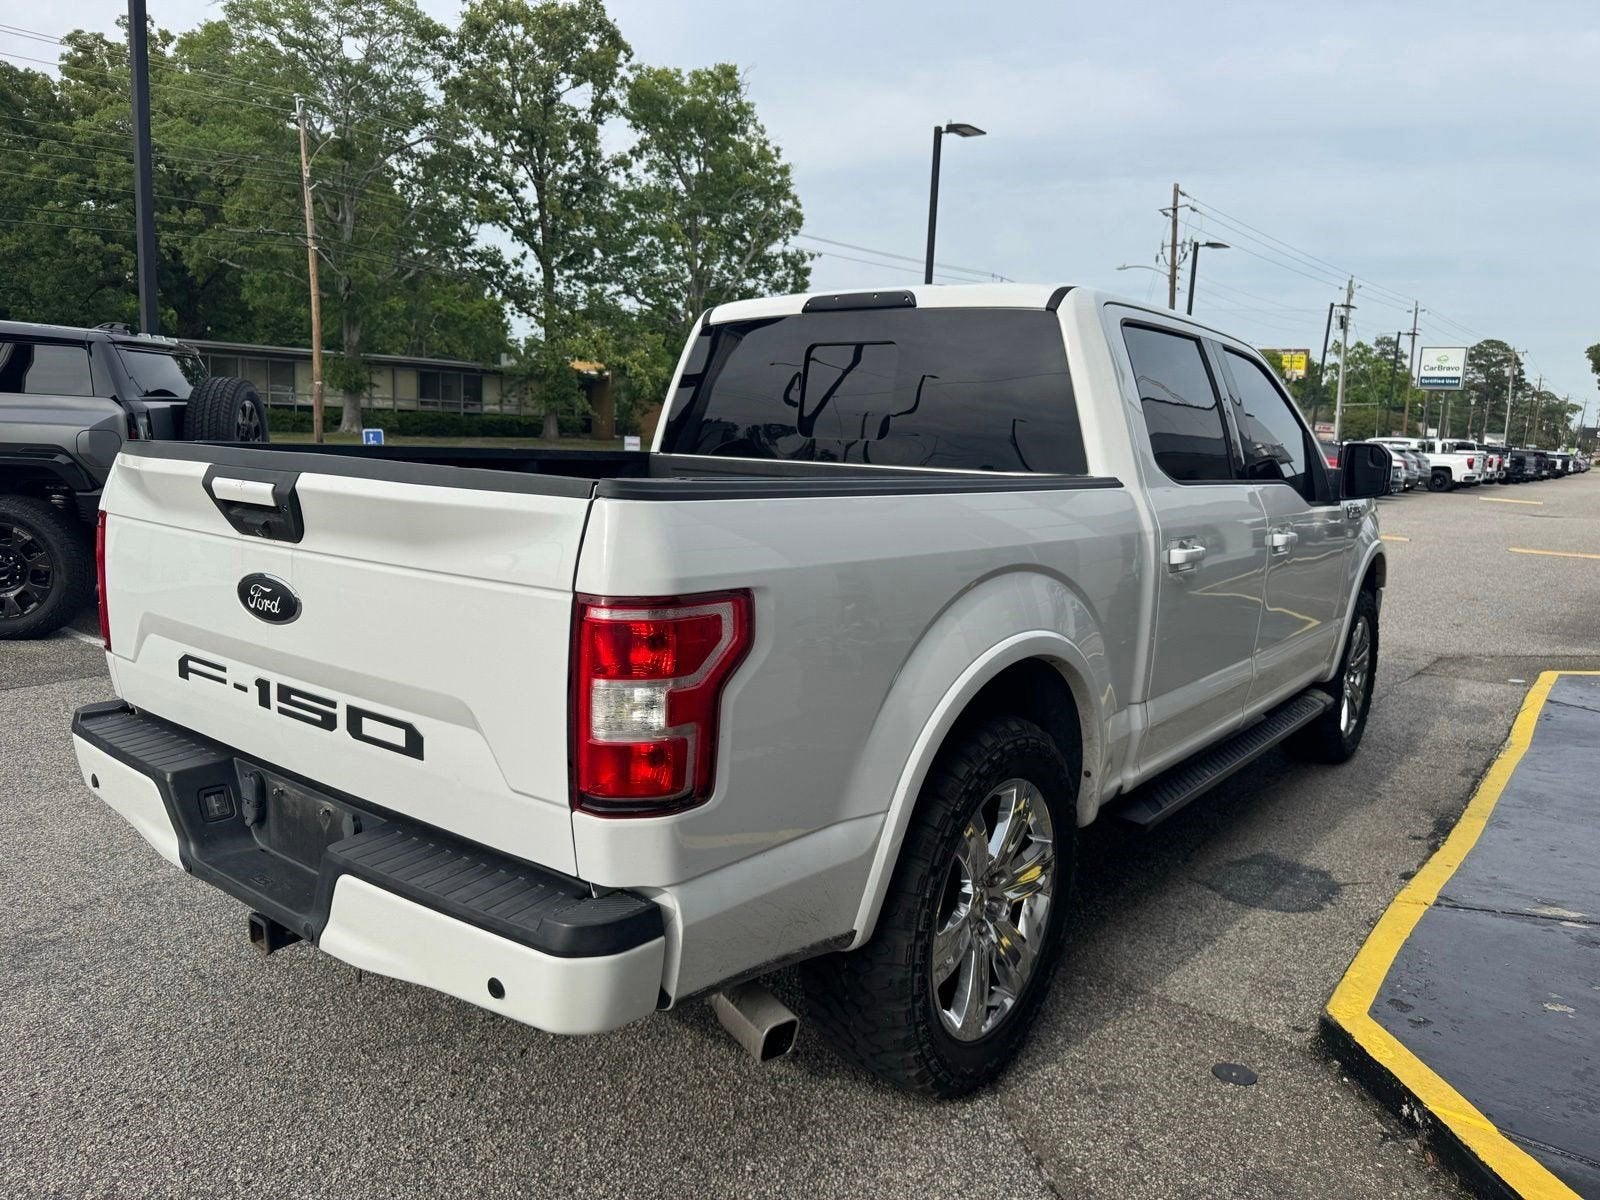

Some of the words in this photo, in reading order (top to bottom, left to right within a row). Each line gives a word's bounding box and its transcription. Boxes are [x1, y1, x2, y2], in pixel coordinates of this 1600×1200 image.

[1423, 364, 1460, 372] CarBravo
[248, 583, 281, 614] Ford
[178, 653, 425, 761] F-150
